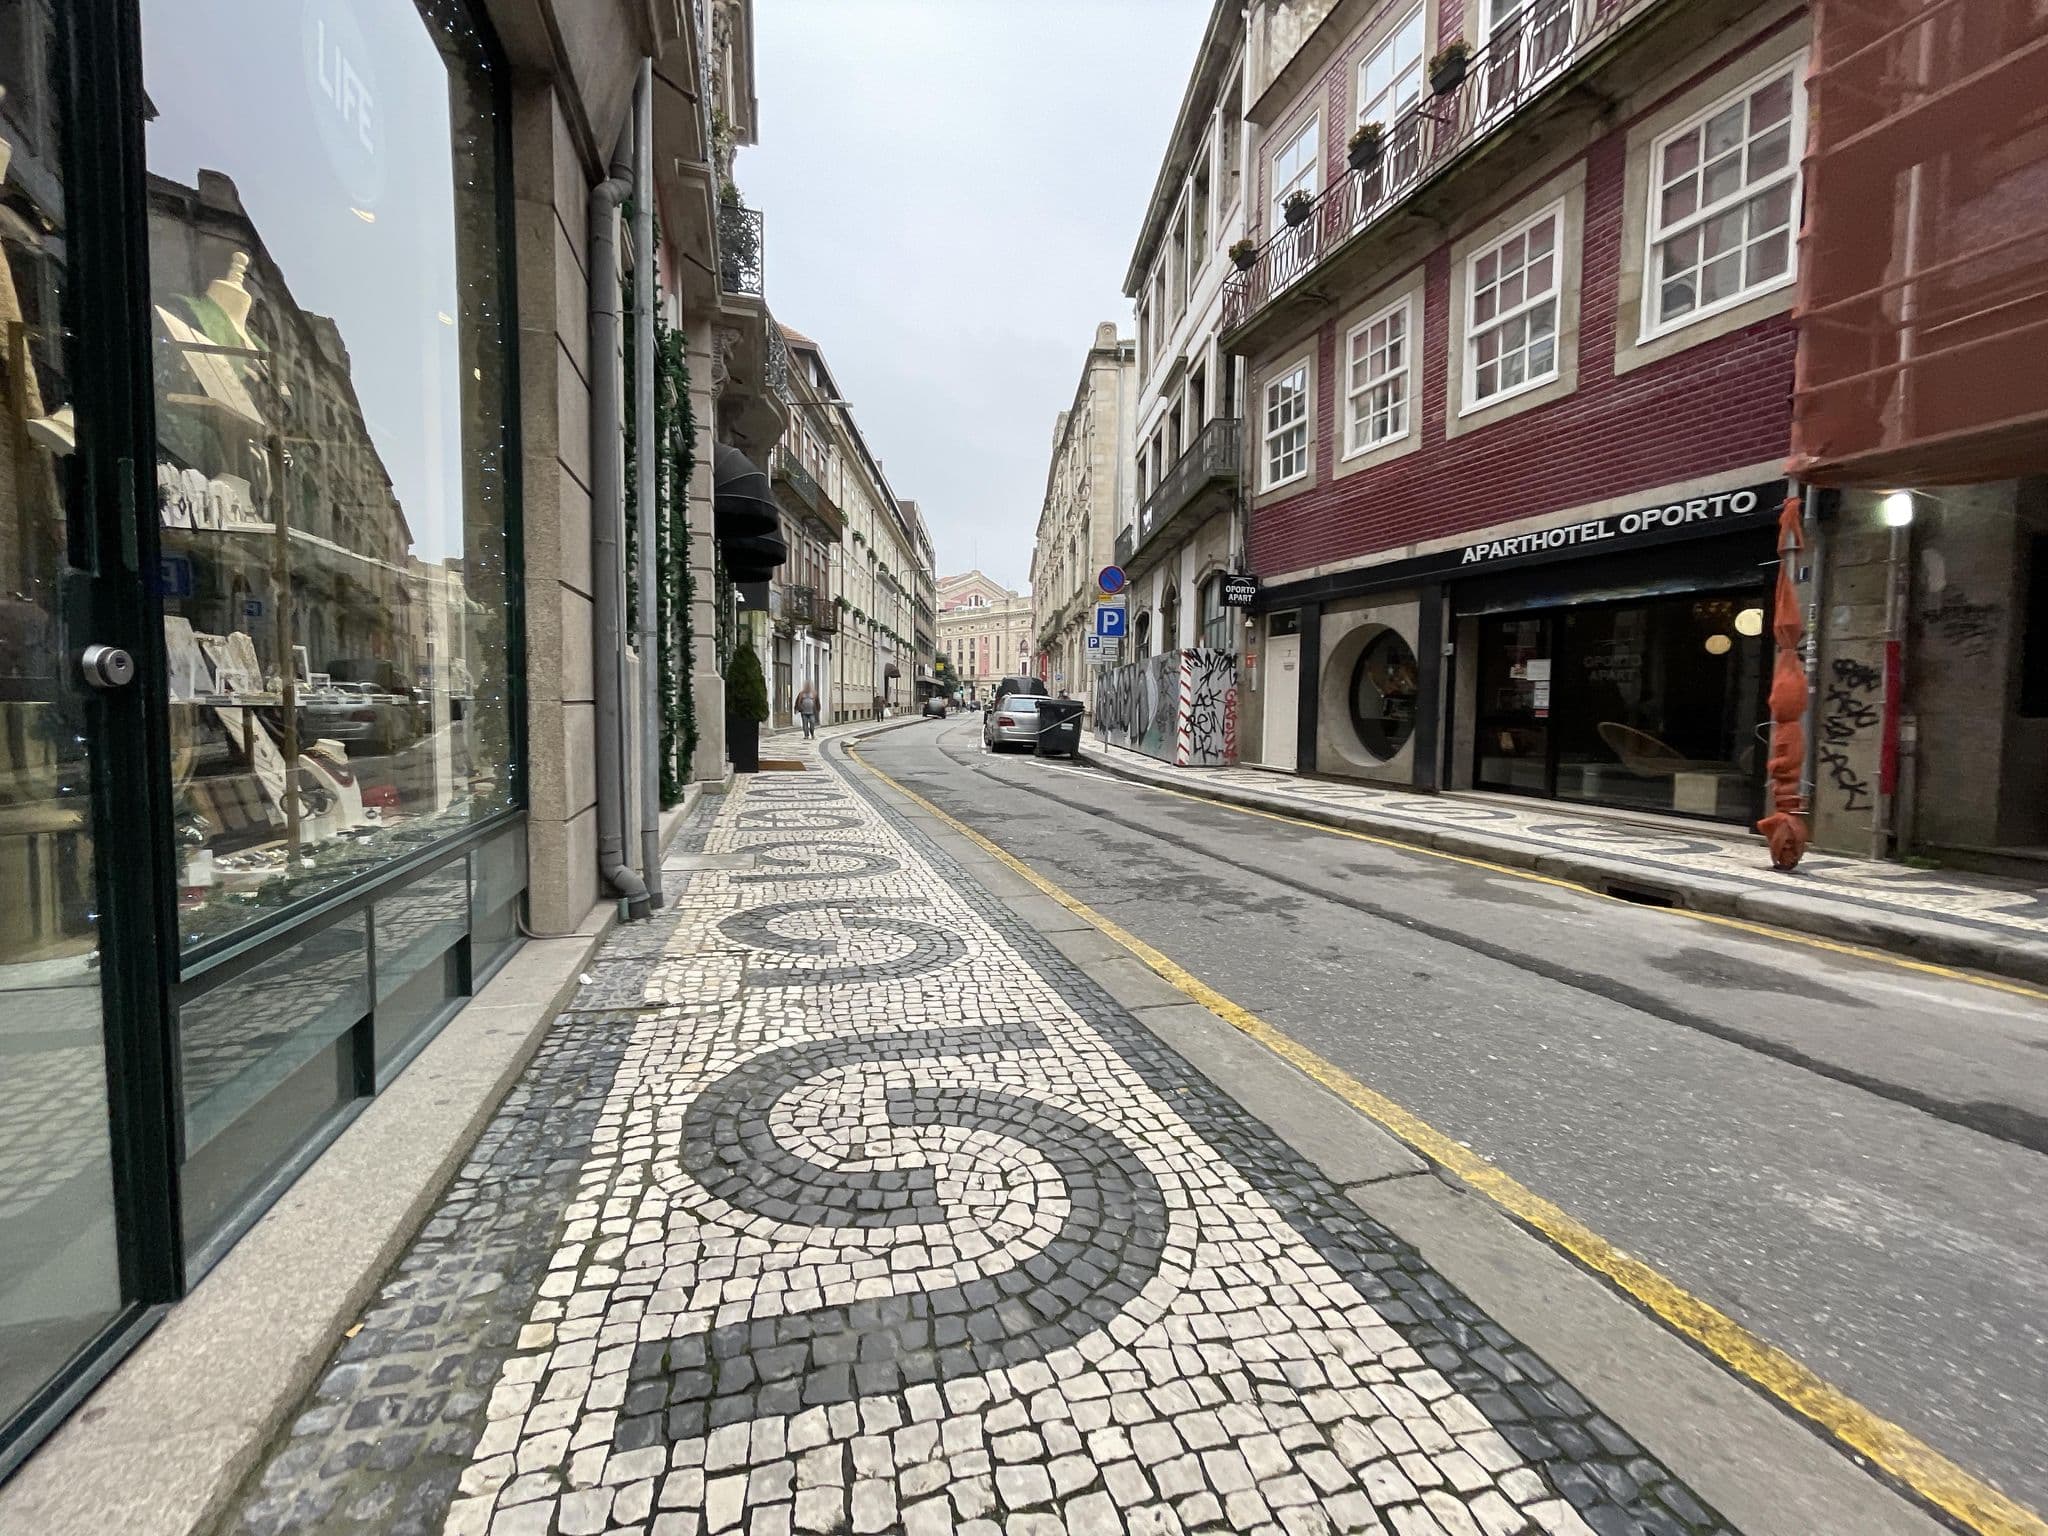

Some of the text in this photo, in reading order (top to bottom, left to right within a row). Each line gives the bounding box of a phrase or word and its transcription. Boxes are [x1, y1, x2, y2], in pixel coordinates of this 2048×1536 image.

[317, 18, 374, 155] LIFE
[1461, 490, 1758, 565] APARTHOTEL OPORTO
[1225, 585, 1256, 594] OPORTO
[1228, 593, 1253, 602] APART
[1103, 611, 1119, 633] P
[1090, 638, 1097, 647] P
